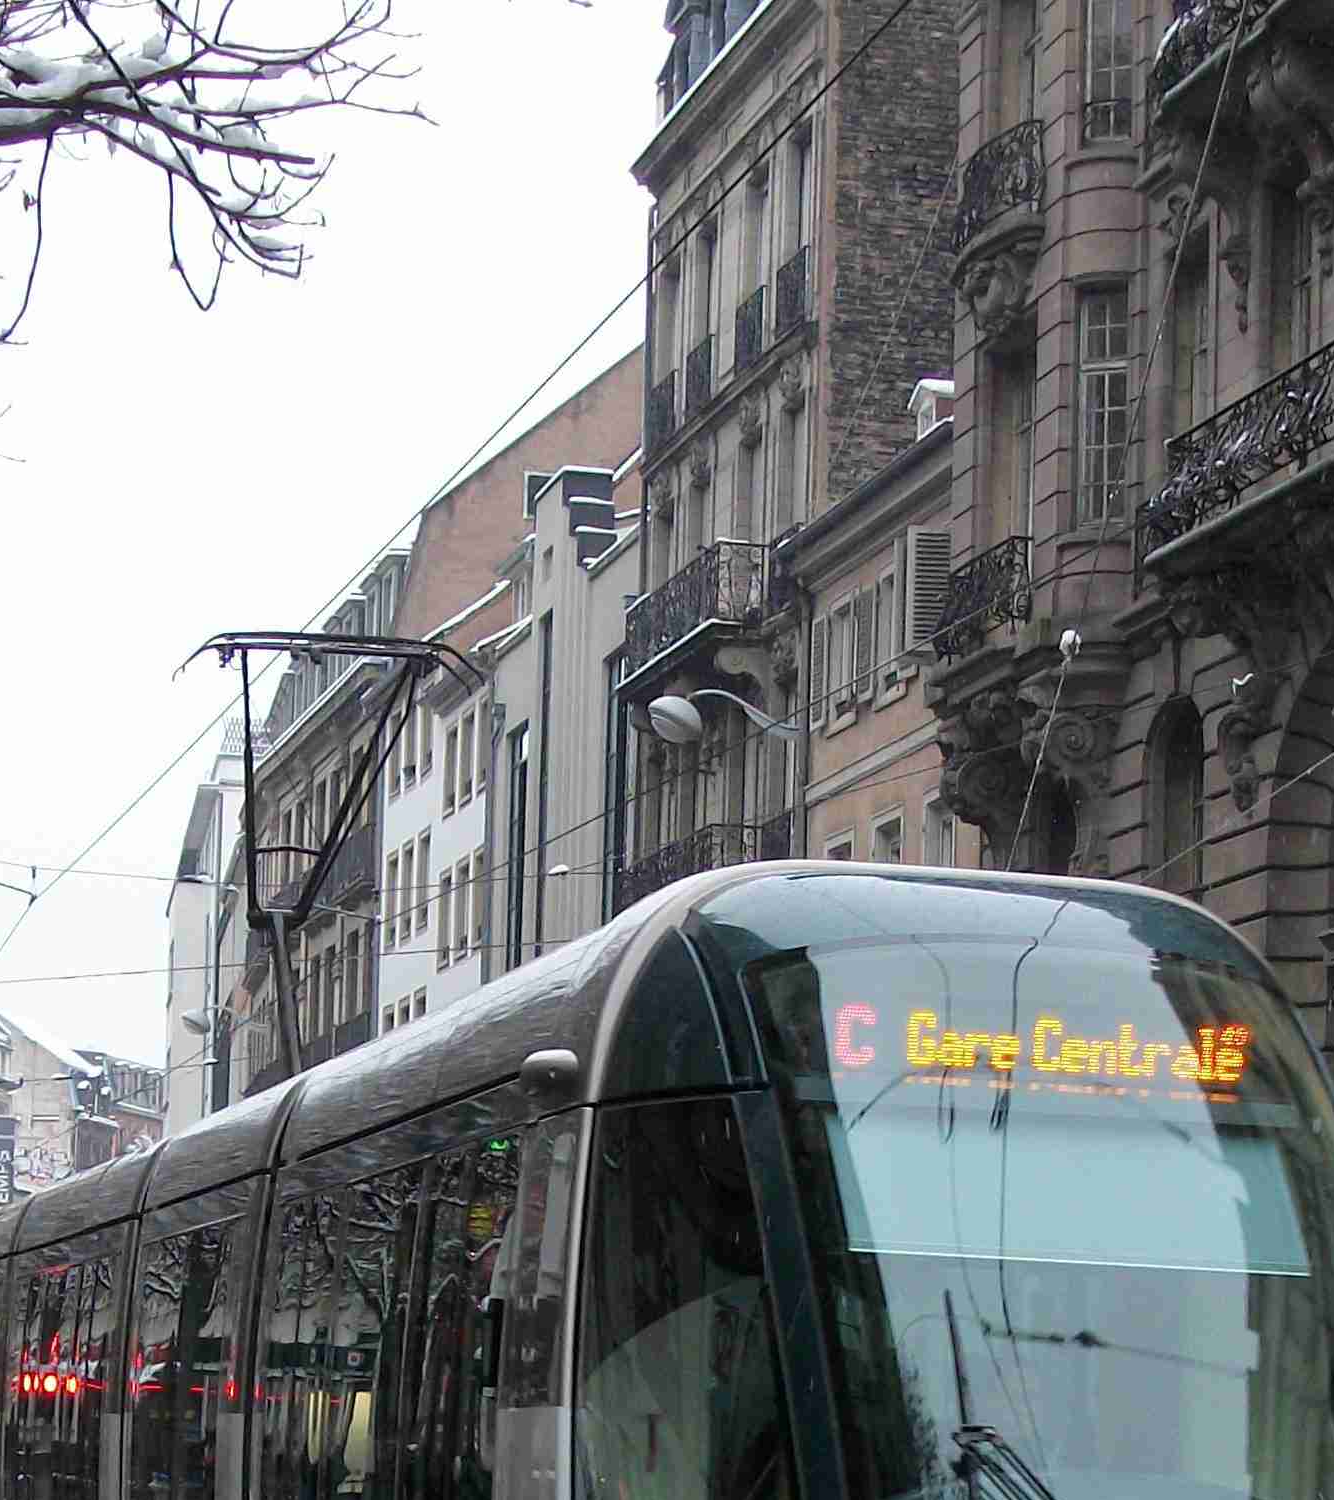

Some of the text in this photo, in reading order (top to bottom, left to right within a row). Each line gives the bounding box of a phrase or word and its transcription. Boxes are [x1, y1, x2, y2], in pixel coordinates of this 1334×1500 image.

[834, 1002, 1245, 1084] C Gare Centrale
